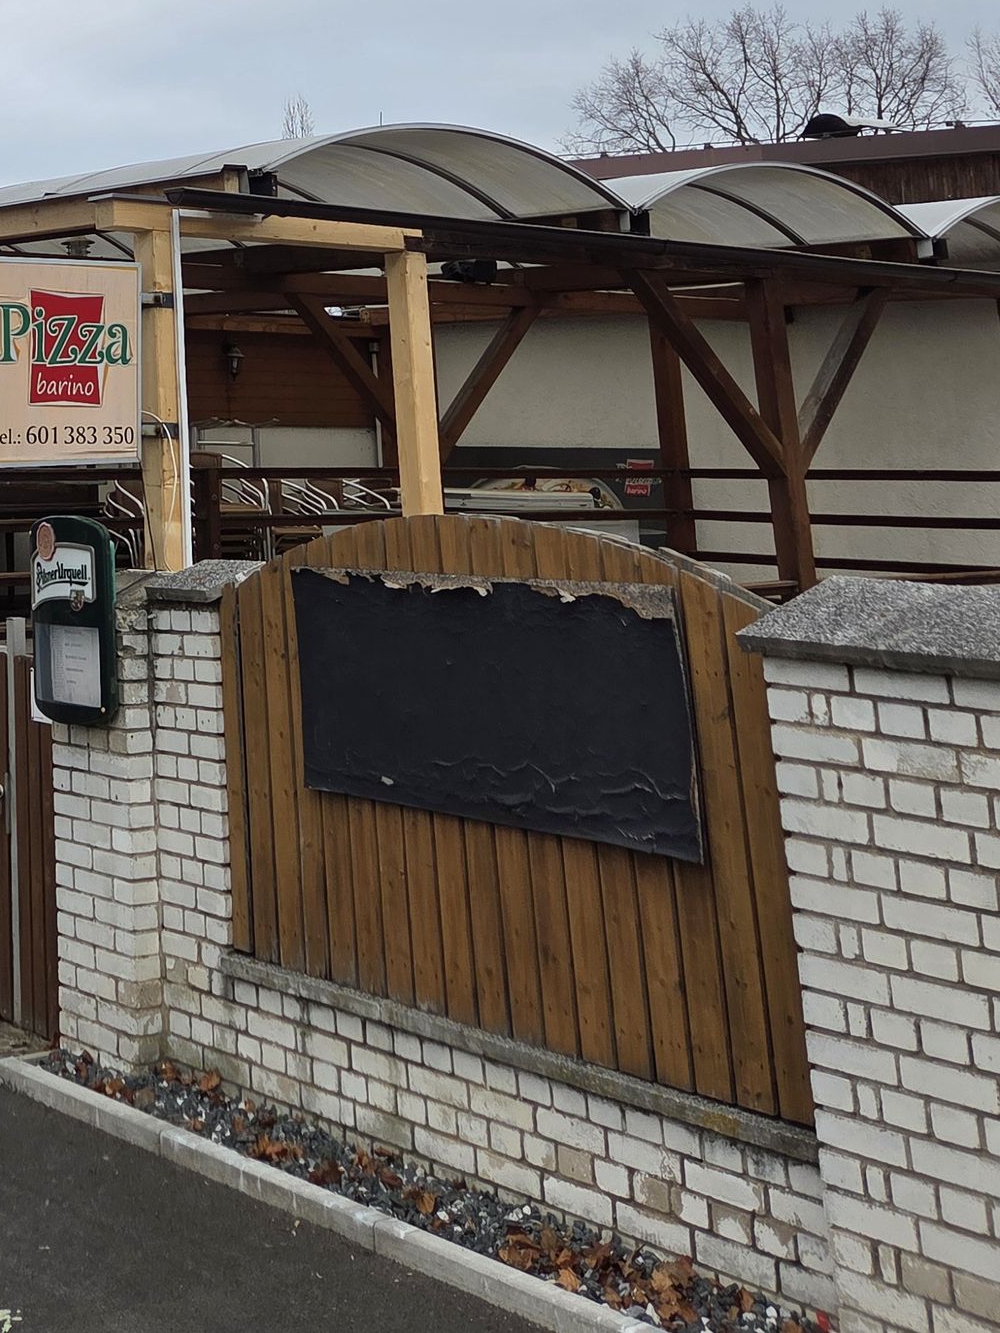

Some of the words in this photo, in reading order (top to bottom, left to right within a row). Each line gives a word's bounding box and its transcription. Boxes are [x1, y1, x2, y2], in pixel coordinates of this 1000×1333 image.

[36, 372, 95, 396] barino
[26, 426, 58, 445] 601
[64, 426, 98, 445] 383
[102, 426, 134, 445] 350
